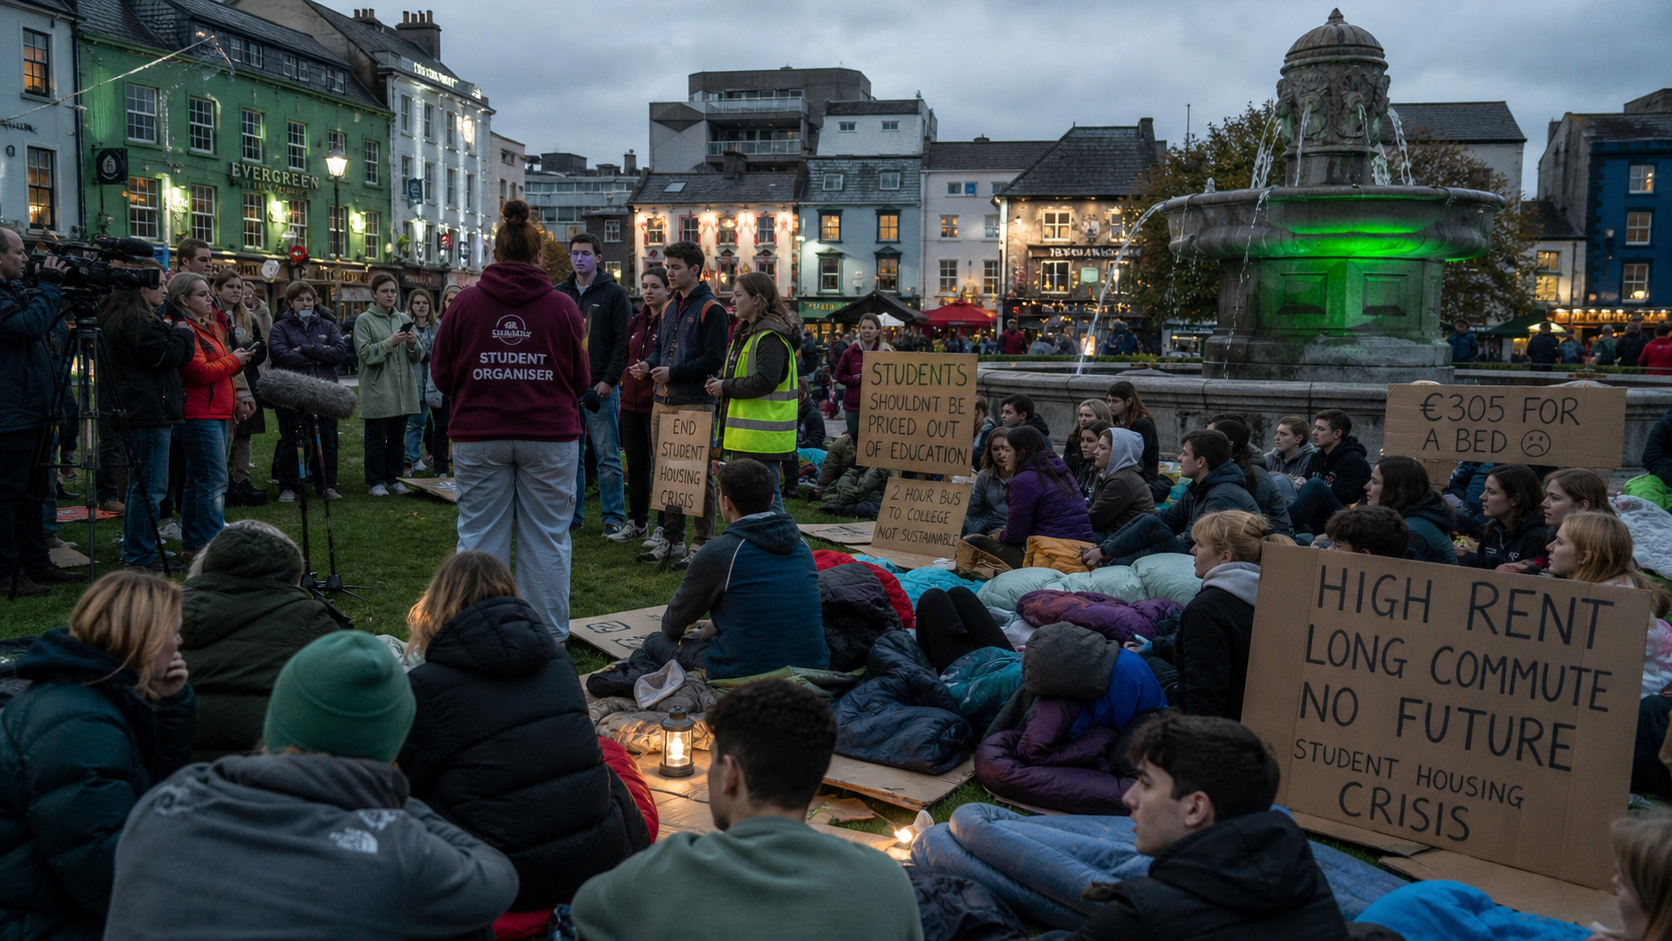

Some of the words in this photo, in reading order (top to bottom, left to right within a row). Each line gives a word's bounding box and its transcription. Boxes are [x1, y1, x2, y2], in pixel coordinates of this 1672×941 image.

[231, 162, 320, 189] EVERGREEN
[480, 352, 547, 365] STUDENT
[473, 368, 554, 381] ORGANISER
[871, 362, 967, 387] STUDENTS
[948, 397, 966, 415] BE
[1420, 393, 1505, 422] €305
[1523, 397, 1580, 426] FOR
[672, 418, 697, 436] END
[868, 415, 917, 436] PRICED
[926, 419, 960, 439] OUT
[661, 441, 705, 461] STUDENT
[865, 440, 883, 458] OF
[890, 442, 968, 466] EDUCATION
[1422, 428, 1440, 451] A
[1455, 428, 1507, 454] BED
[660, 465, 701, 488] HOUSING
[660, 490, 694, 509] CRISIS
[890, 485, 901, 501] 2
[904, 487, 935, 504] HOUR
[939, 489, 962, 506] BUS
[888, 506, 902, 520] TO
[907, 507, 952, 525] COLLEGE
[876, 525, 899, 541] NOT
[900, 528, 959, 548] SUSTAINABLE
[1317, 564, 1433, 624] HIGH
[1466, 581, 1615, 650] RENT
[1305, 624, 1408, 679] LONG
[1430, 645, 1613, 713] COMMUTE
[1300, 681, 1359, 727] NO
[1396, 697, 1577, 772] FUTURE
[1293, 739, 1400, 779] STUDENT
[1416, 764, 1525, 810] HOUSING
[1338, 781, 1470, 842] CRISIS
